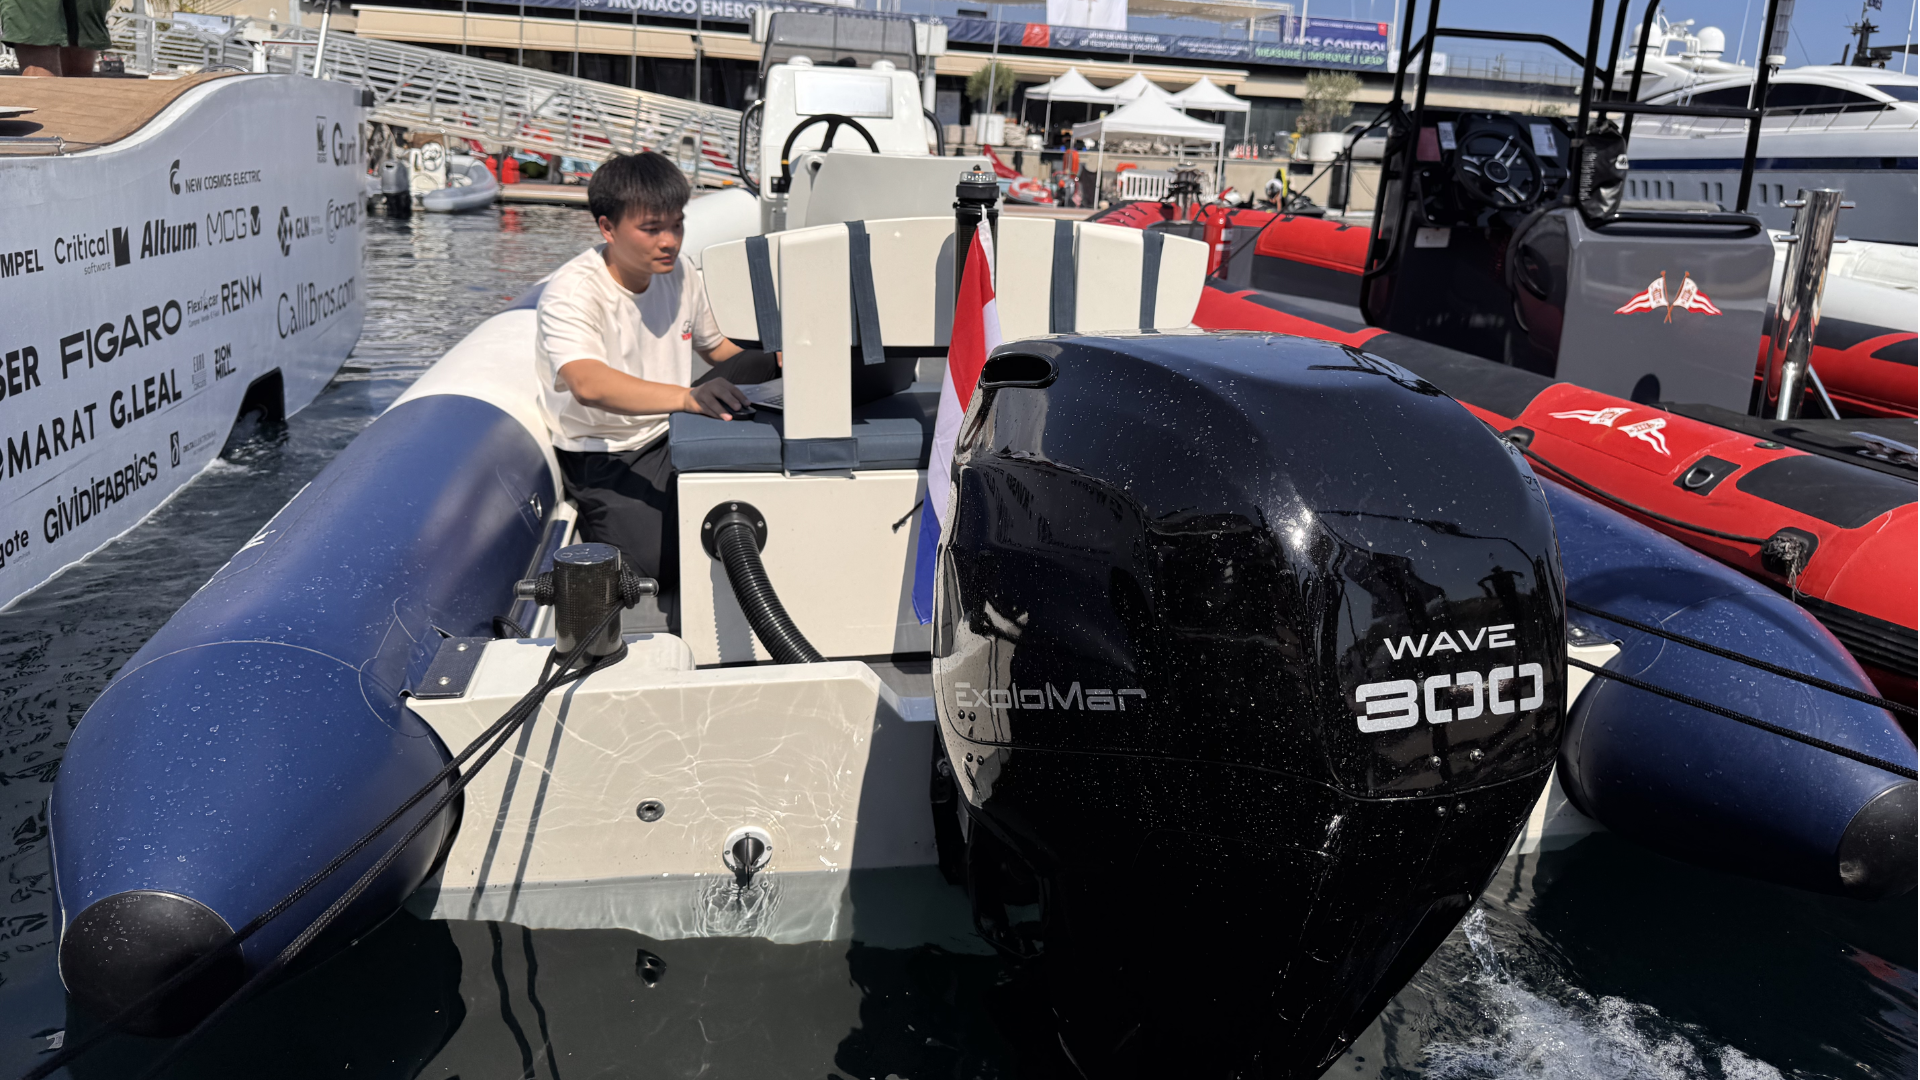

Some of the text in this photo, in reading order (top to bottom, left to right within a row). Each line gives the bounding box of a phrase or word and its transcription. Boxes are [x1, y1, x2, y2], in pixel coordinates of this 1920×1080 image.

[607, 0, 698, 14] MONACO
[701, 2, 763, 19] ENERG
[1307, 51, 1352, 62] IMPROVE
[1359, 54, 1384, 66] LEAD
[185, 169, 261, 193] NEW COSMOS ELECTRIC
[140, 218, 198, 259] Altium
[206, 207, 247, 246] MCG
[0, 249, 44, 278] MPEL
[54, 229, 110, 265] Critical
[84, 262, 111, 275] software
[277, 276, 356, 339] CalliBros.com
[60, 299, 182, 380] FIGARO
[109, 369, 182, 429] G.LEAL
[1383, 623, 1516, 661] WAVE
[954, 681, 1147, 711] ExploMar
[1355, 662, 1545, 734] 300
